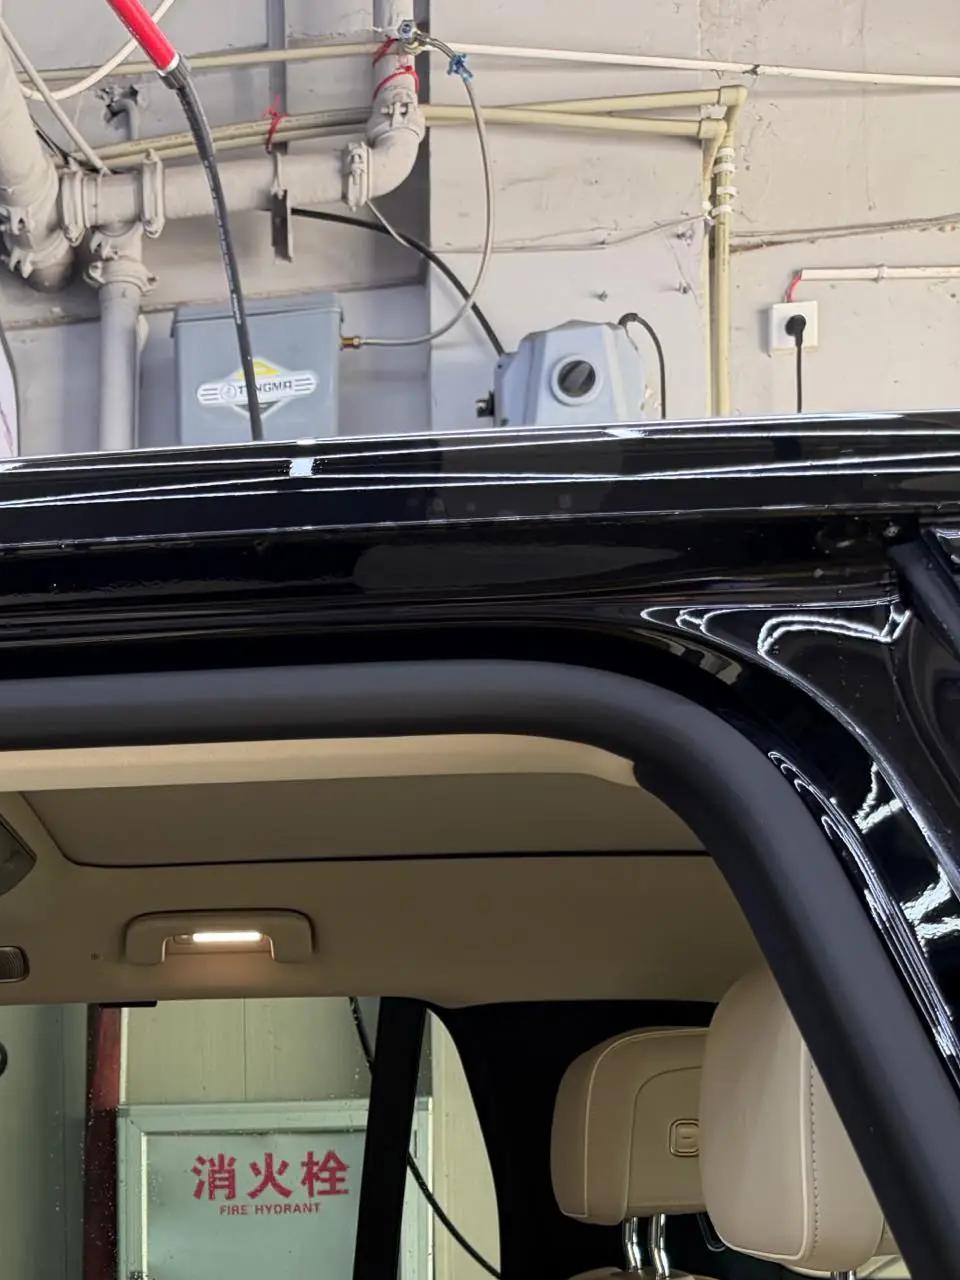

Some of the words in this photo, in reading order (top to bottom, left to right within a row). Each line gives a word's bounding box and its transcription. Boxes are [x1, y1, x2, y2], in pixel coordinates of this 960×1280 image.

[238, 380, 292, 394] TNGMA
[191, 1150, 349, 1200] 消火栓
[219, 1204, 248, 1216] FIRE
[254, 1203, 321, 1215] HYDRANT
